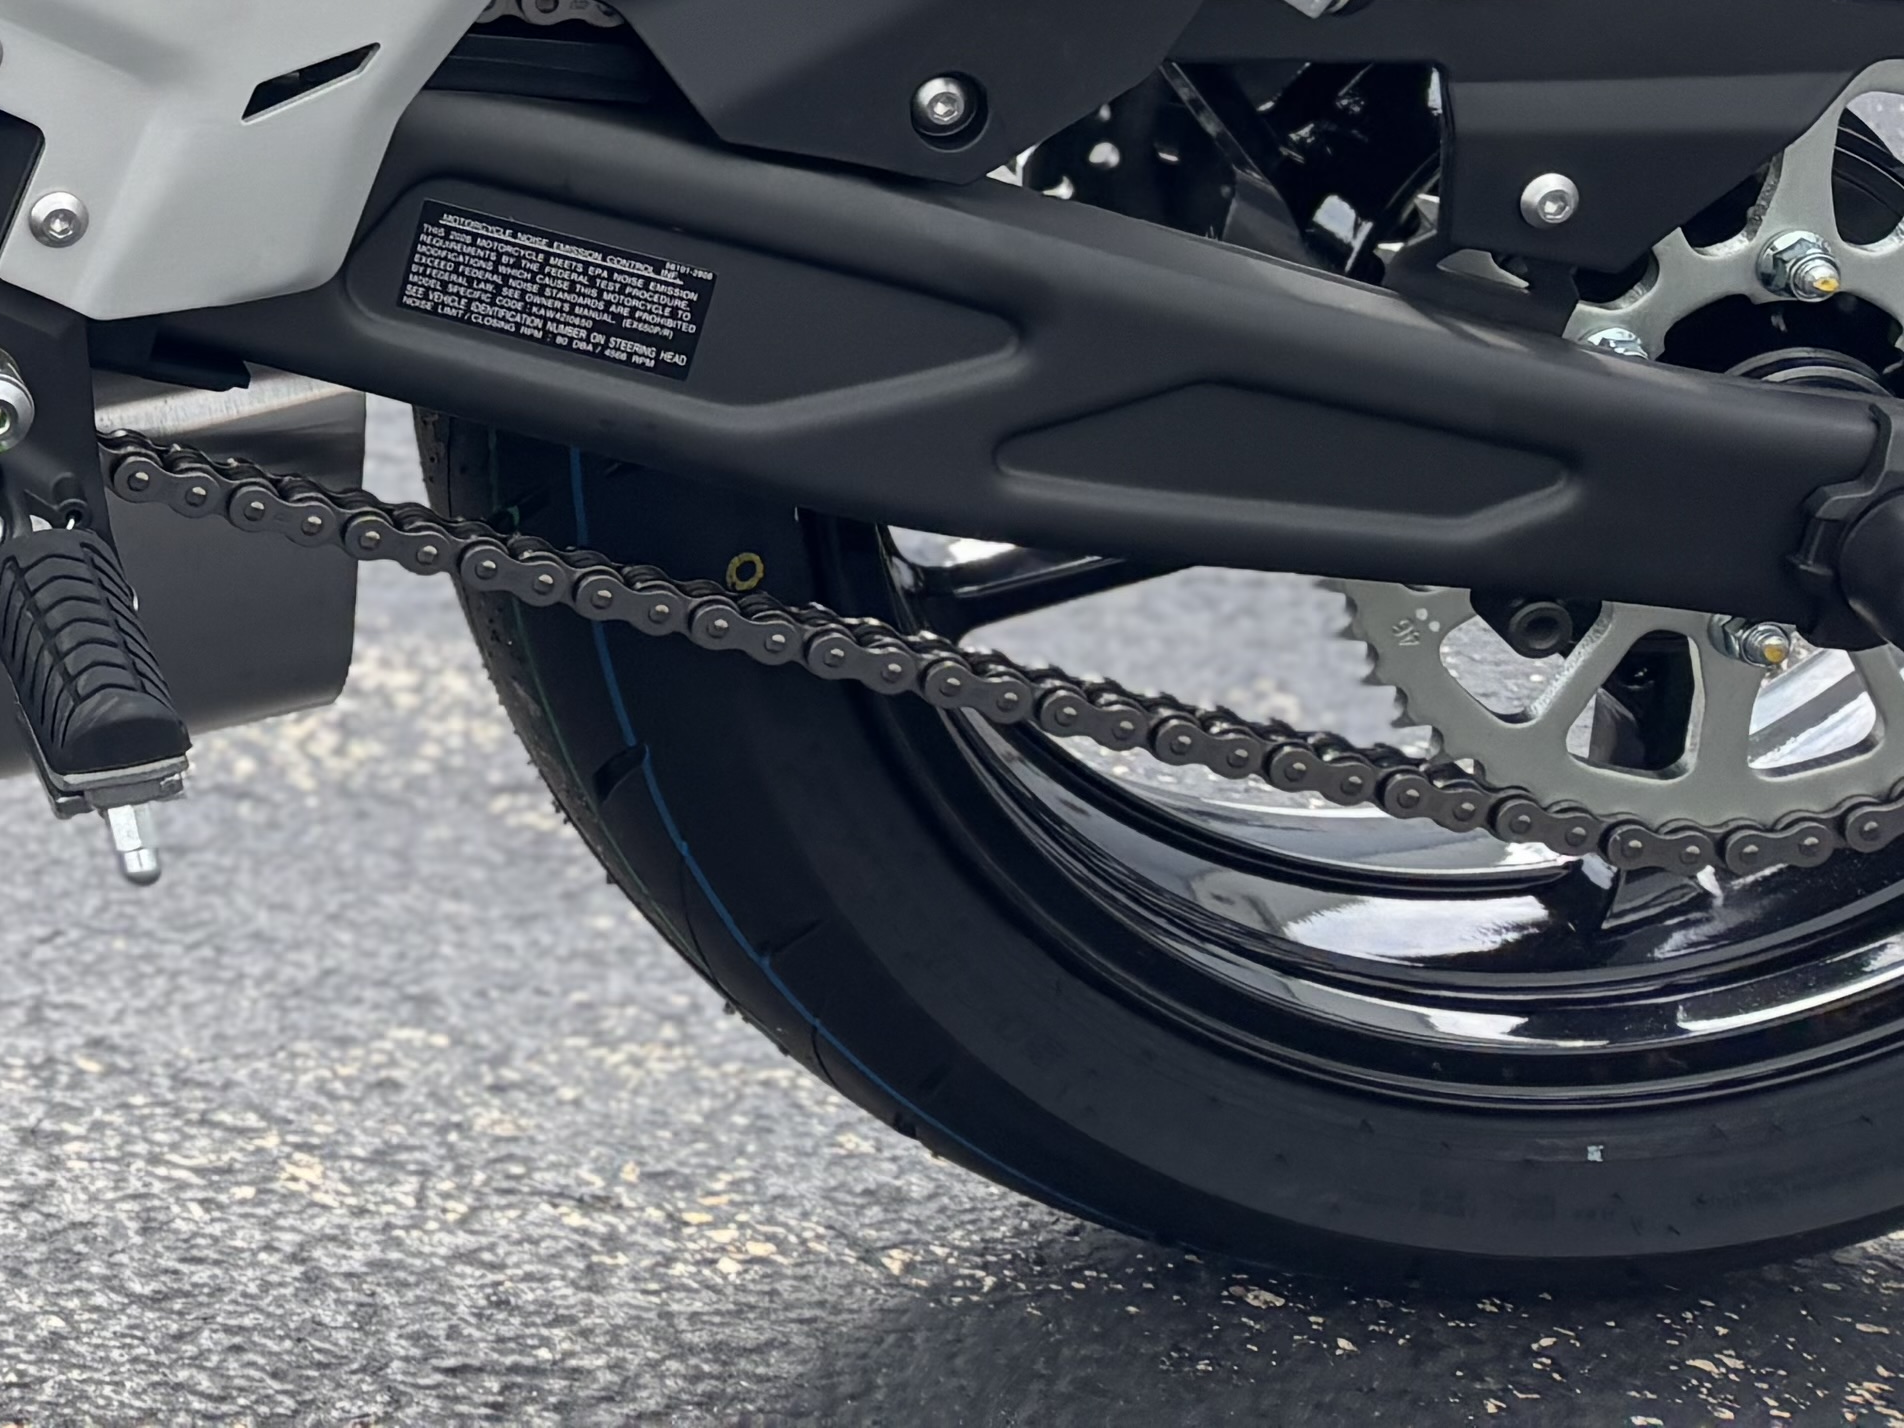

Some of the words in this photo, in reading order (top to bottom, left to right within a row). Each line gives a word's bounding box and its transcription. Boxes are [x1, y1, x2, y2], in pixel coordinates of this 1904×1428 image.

[416, 242, 494, 271] MODIFICATIONS
[496, 263, 532, 280] WHICH
[534, 273, 570, 290] CAUSE
[573, 283, 598, 298] THIS
[601, 291, 672, 317] MOTORCYCLE
[675, 310, 691, 322] TO
[418, 232, 497, 261] REQUIREMENTS
[500, 253, 516, 266] BY
[519, 258, 540, 272] THE
[543, 264, 591, 285] FEDERAL
[593, 278, 620, 293] TEST
[624, 285, 691, 311] PROCEDURE.
[421, 223, 446, 237] THIS
[475, 237, 545, 262] MOTORCYCLE
[548, 255, 584, 272] MEETS
[586, 265, 609, 279] EPA
[611, 272, 644, 288] NOISE
[648, 281, 698, 302] EMISSION
[442, 212, 512, 238] MOTORCYCLE
[515, 231, 549, 248] NOISE
[551, 240, 603, 262] EMISSION
[604, 254, 657, 276] CONTROL
[404, 283, 425, 298] SEE
[426, 289, 468, 309] VEHICLE
[469, 300, 544, 329] IDENTIFICATION
[545, 319, 588, 340] NUMBER
[588, 331, 606, 345] ON
[607, 336, 657, 358] STEERING
[658, 349, 687, 366] HEAD
[407, 273, 443, 290] MODEL
[446, 283, 492, 302] SPECIFIC
[410, 262, 424, 274] BY
[425, 266, 469, 286] FEDERAL
[500, 286, 521, 299] SEE
[573, 305, 617, 324] MANUAL.
[413, 252, 455, 271] EXCEED
[457, 264, 504, 284] FEDERAL
[507, 277, 539, 293] NOISE
[543, 286, 605, 310] STANDARDS
[608, 303, 630, 317] ARE
[633, 310, 696, 334] PROHIBITED
[401, 295, 434, 311] NOISE
[519, 325, 543, 339] RPM
[571, 339, 594, 352] DBA
[630, 354, 655, 368] RPM
